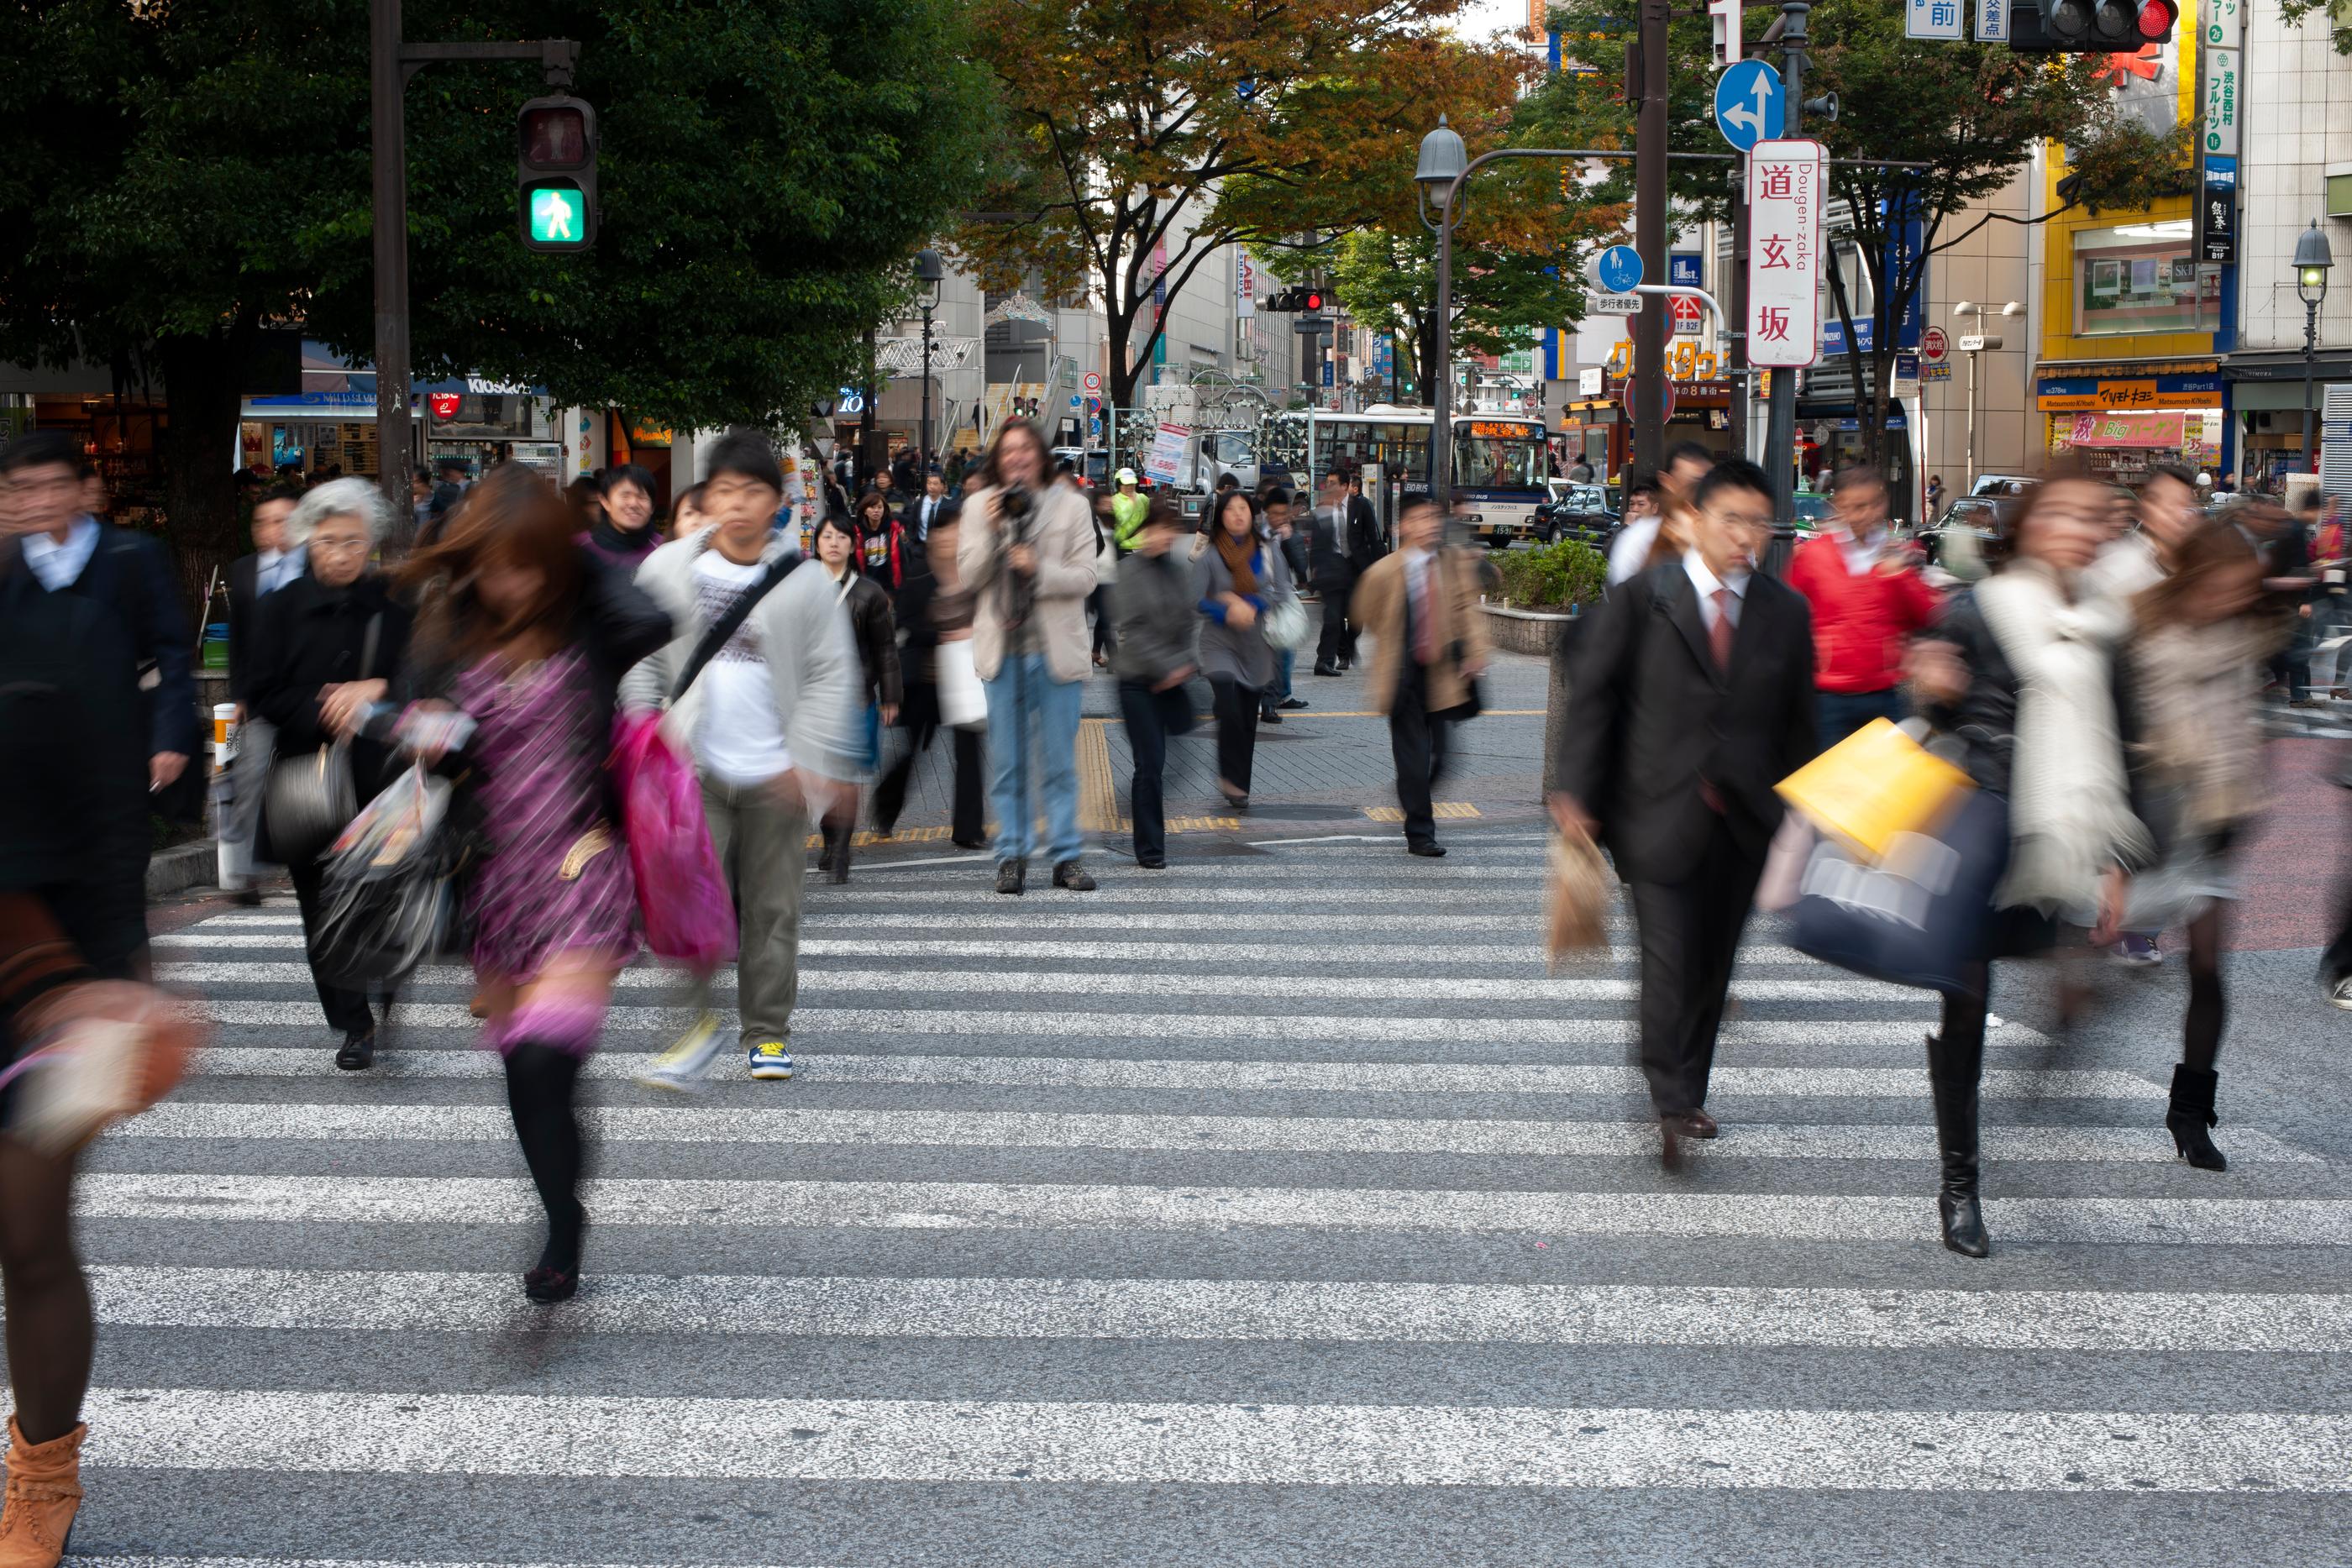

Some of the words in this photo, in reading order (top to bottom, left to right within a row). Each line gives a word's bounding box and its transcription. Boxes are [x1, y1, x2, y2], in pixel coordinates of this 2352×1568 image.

[2211, 28, 2221, 39] 2F
[2209, 77, 2220, 129] フルーツ
[2223, 71, 2234, 126] 渋谷西村
[2210, 136, 2218, 147] 1F
[1794, 164, 1813, 270] Dougen-zaka
[1757, 164, 1793, 342] 道玄坂
[1244, 254, 1252, 298] LABI
[1600, 299, 1640, 310] 歩行者優先
[1687, 322, 1698, 330] B2F
[1925, 339, 1944, 351] 消火栓
[1088, 377, 1098, 385] 30
[1415, 484, 1428, 493] BUS
